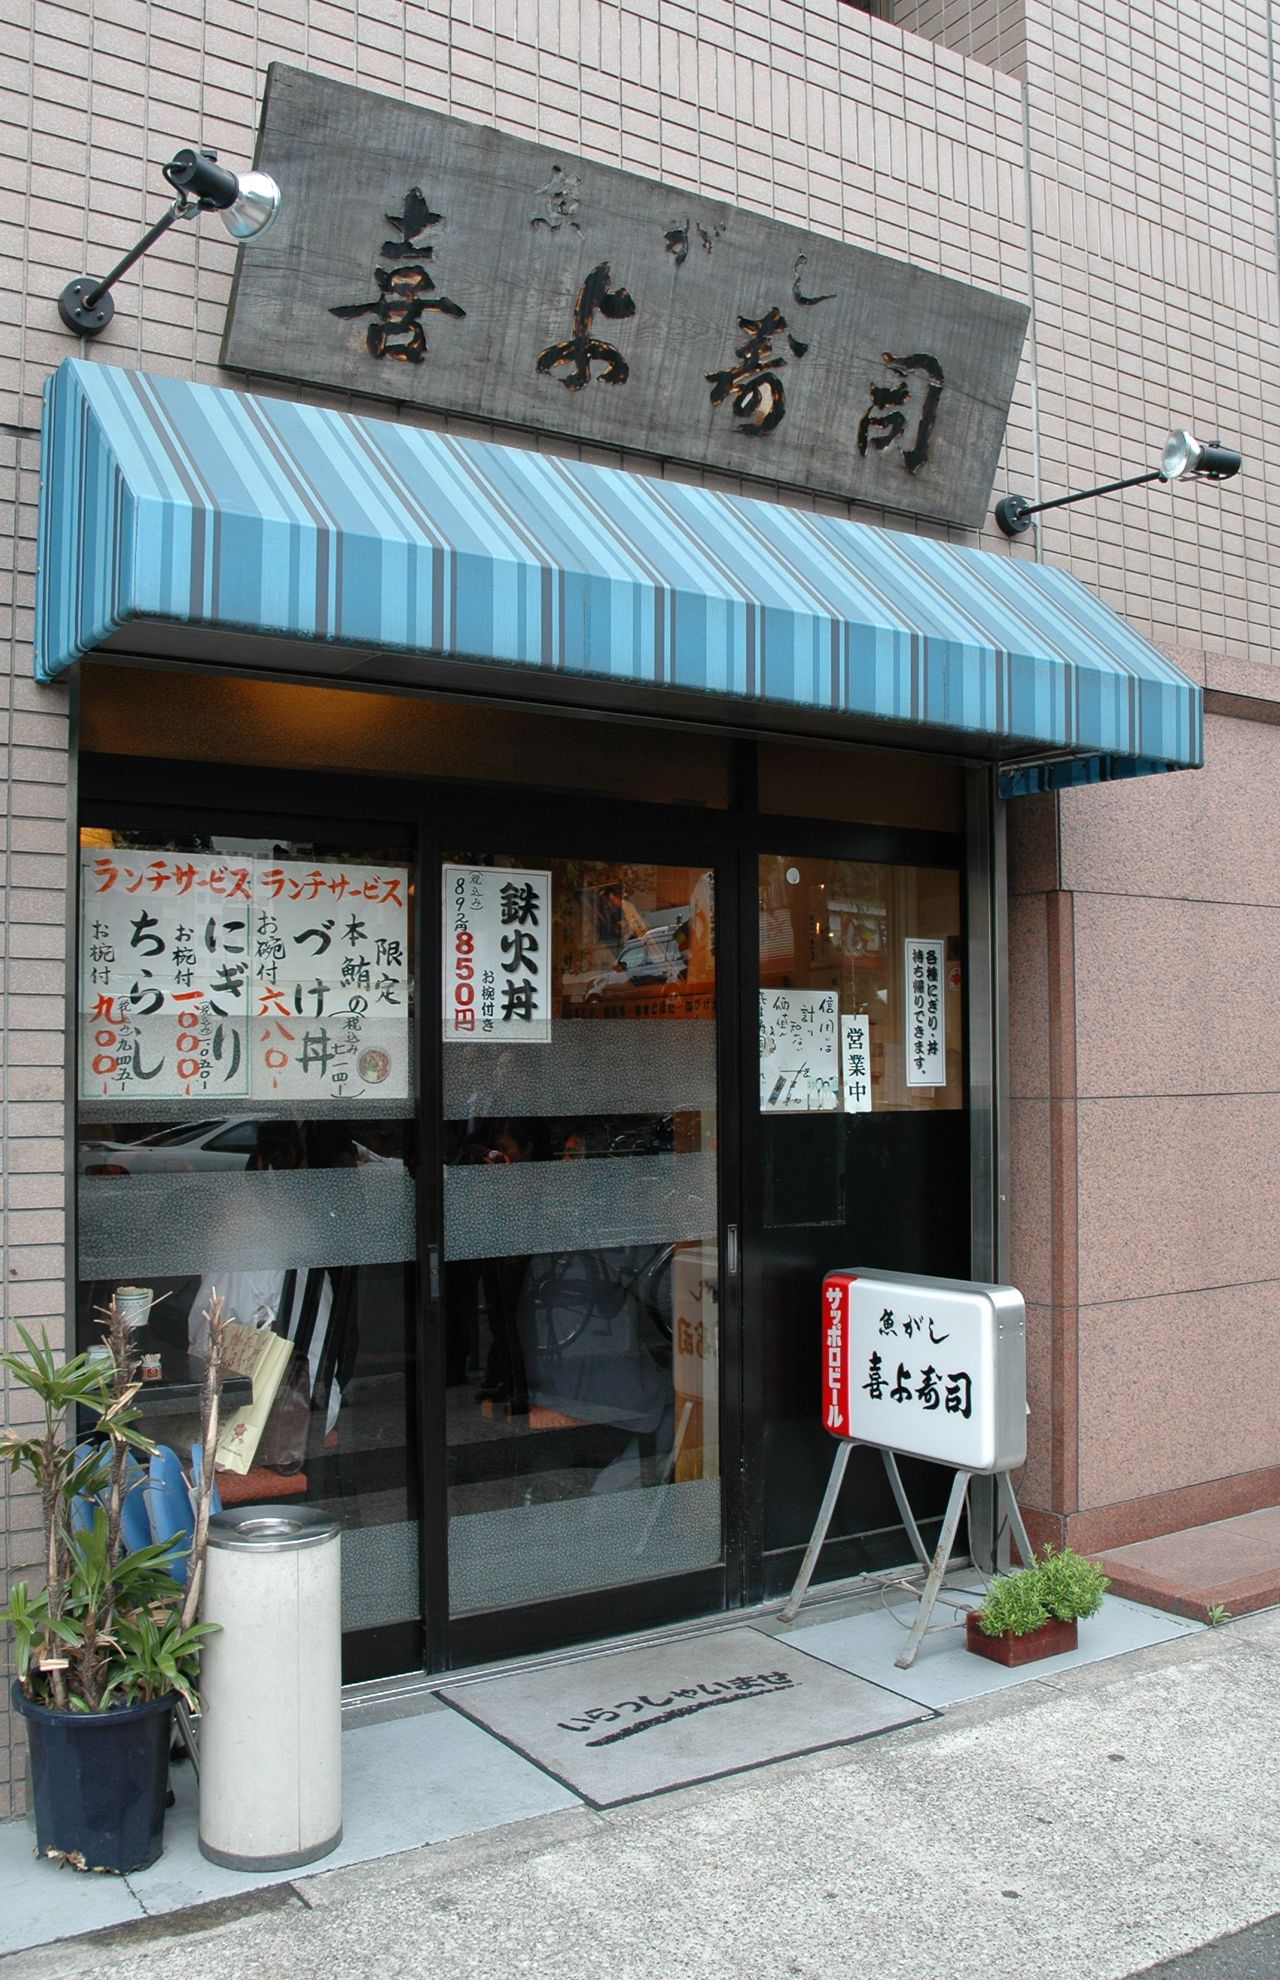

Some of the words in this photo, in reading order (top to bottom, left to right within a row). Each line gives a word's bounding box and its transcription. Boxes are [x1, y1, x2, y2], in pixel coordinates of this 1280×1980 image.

[92, 857, 253, 901] ランチサービス
[260, 868, 404, 909] ランチサービス
[129, 909, 165, 1080] ちらし
[374, 938, 402, 1005] 限定
[454, 931, 475, 1032] 850円
[500, 882, 540, 1022] 鉄火丼
[204, 917, 248, 1082] にぎり
[293, 919, 335, 1079] づけ丼
[847, 1027, 866, 1102] 営業中
[826, 1287, 844, 1428] サッポロビール
[879, 1308, 950, 1345] 魚がし
[557, 1670, 793, 1733] いらっしゃいませ
